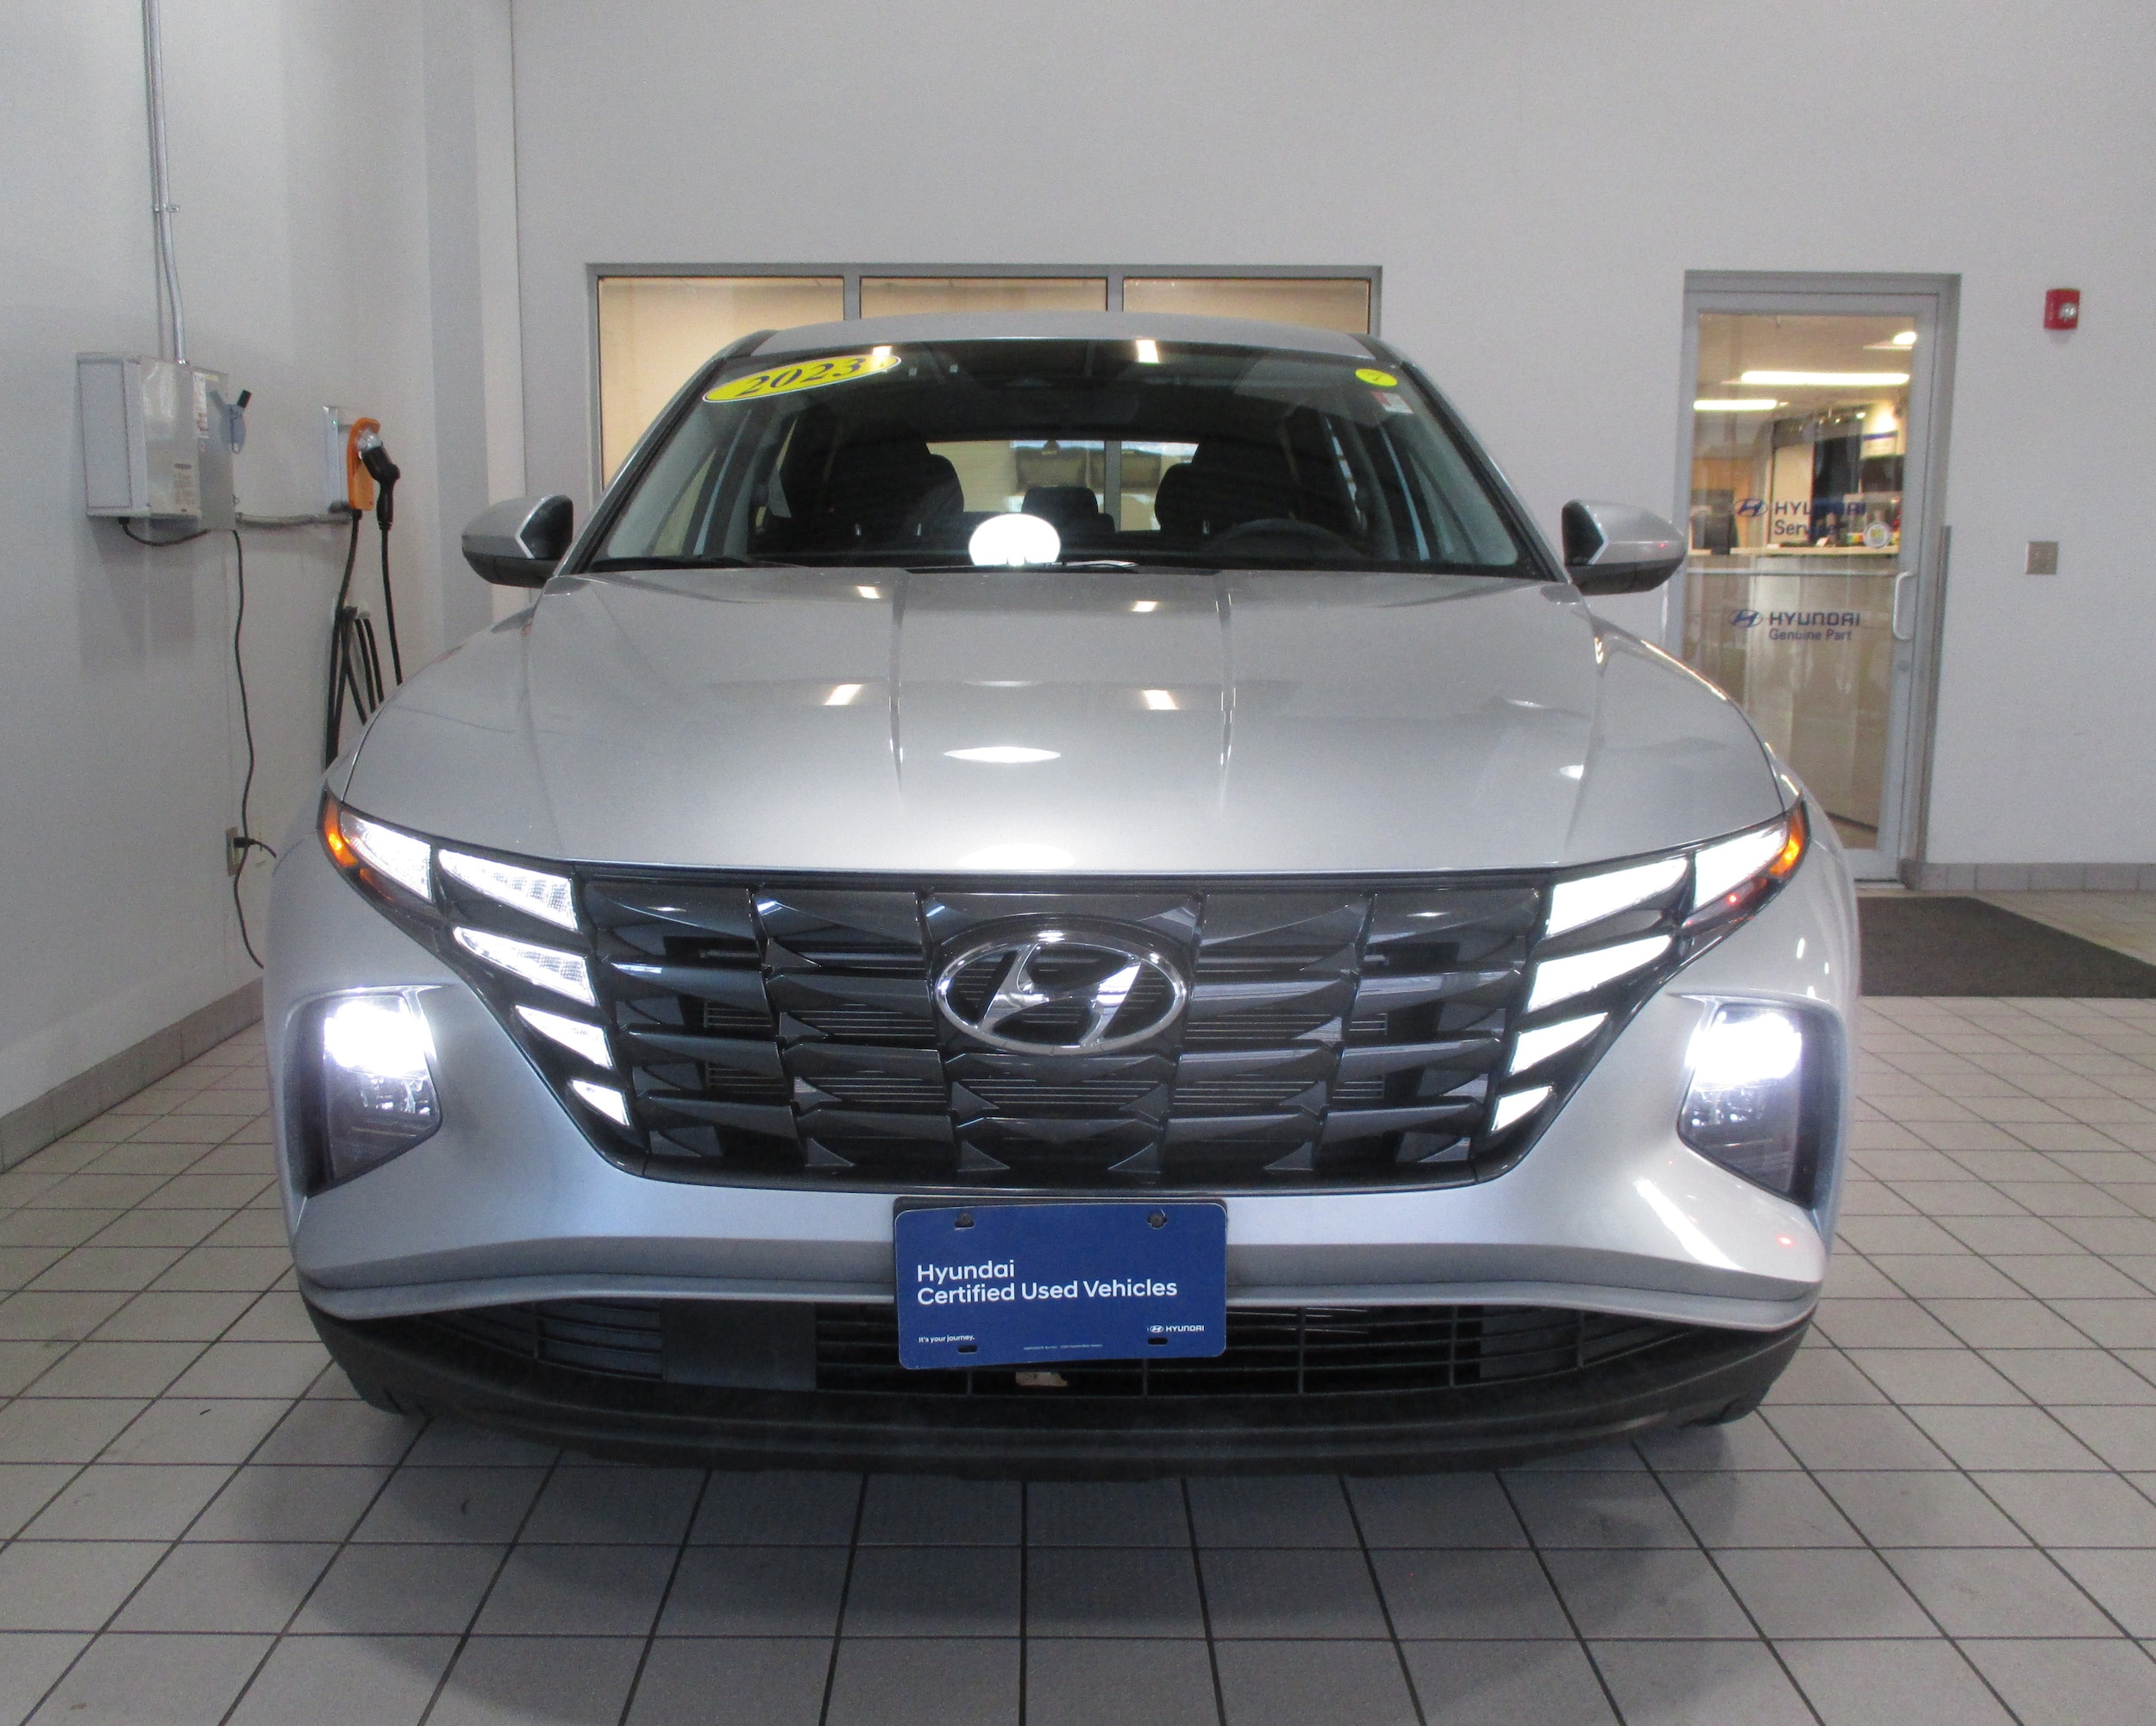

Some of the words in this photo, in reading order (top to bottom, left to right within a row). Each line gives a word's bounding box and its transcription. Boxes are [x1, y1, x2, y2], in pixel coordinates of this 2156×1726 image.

[735, 358, 866, 397] 2023
[1770, 612, 1860, 626] HYUNDAI
[918, 1259, 1014, 1284] Hyundai
[918, 1283, 1015, 1305] Certified
[1022, 1281, 1077, 1300] Used
[1083, 1278, 1177, 1297] Vehicles
[930, 1335, 946, 1344] your
[947, 1334, 975, 1343] journey.
